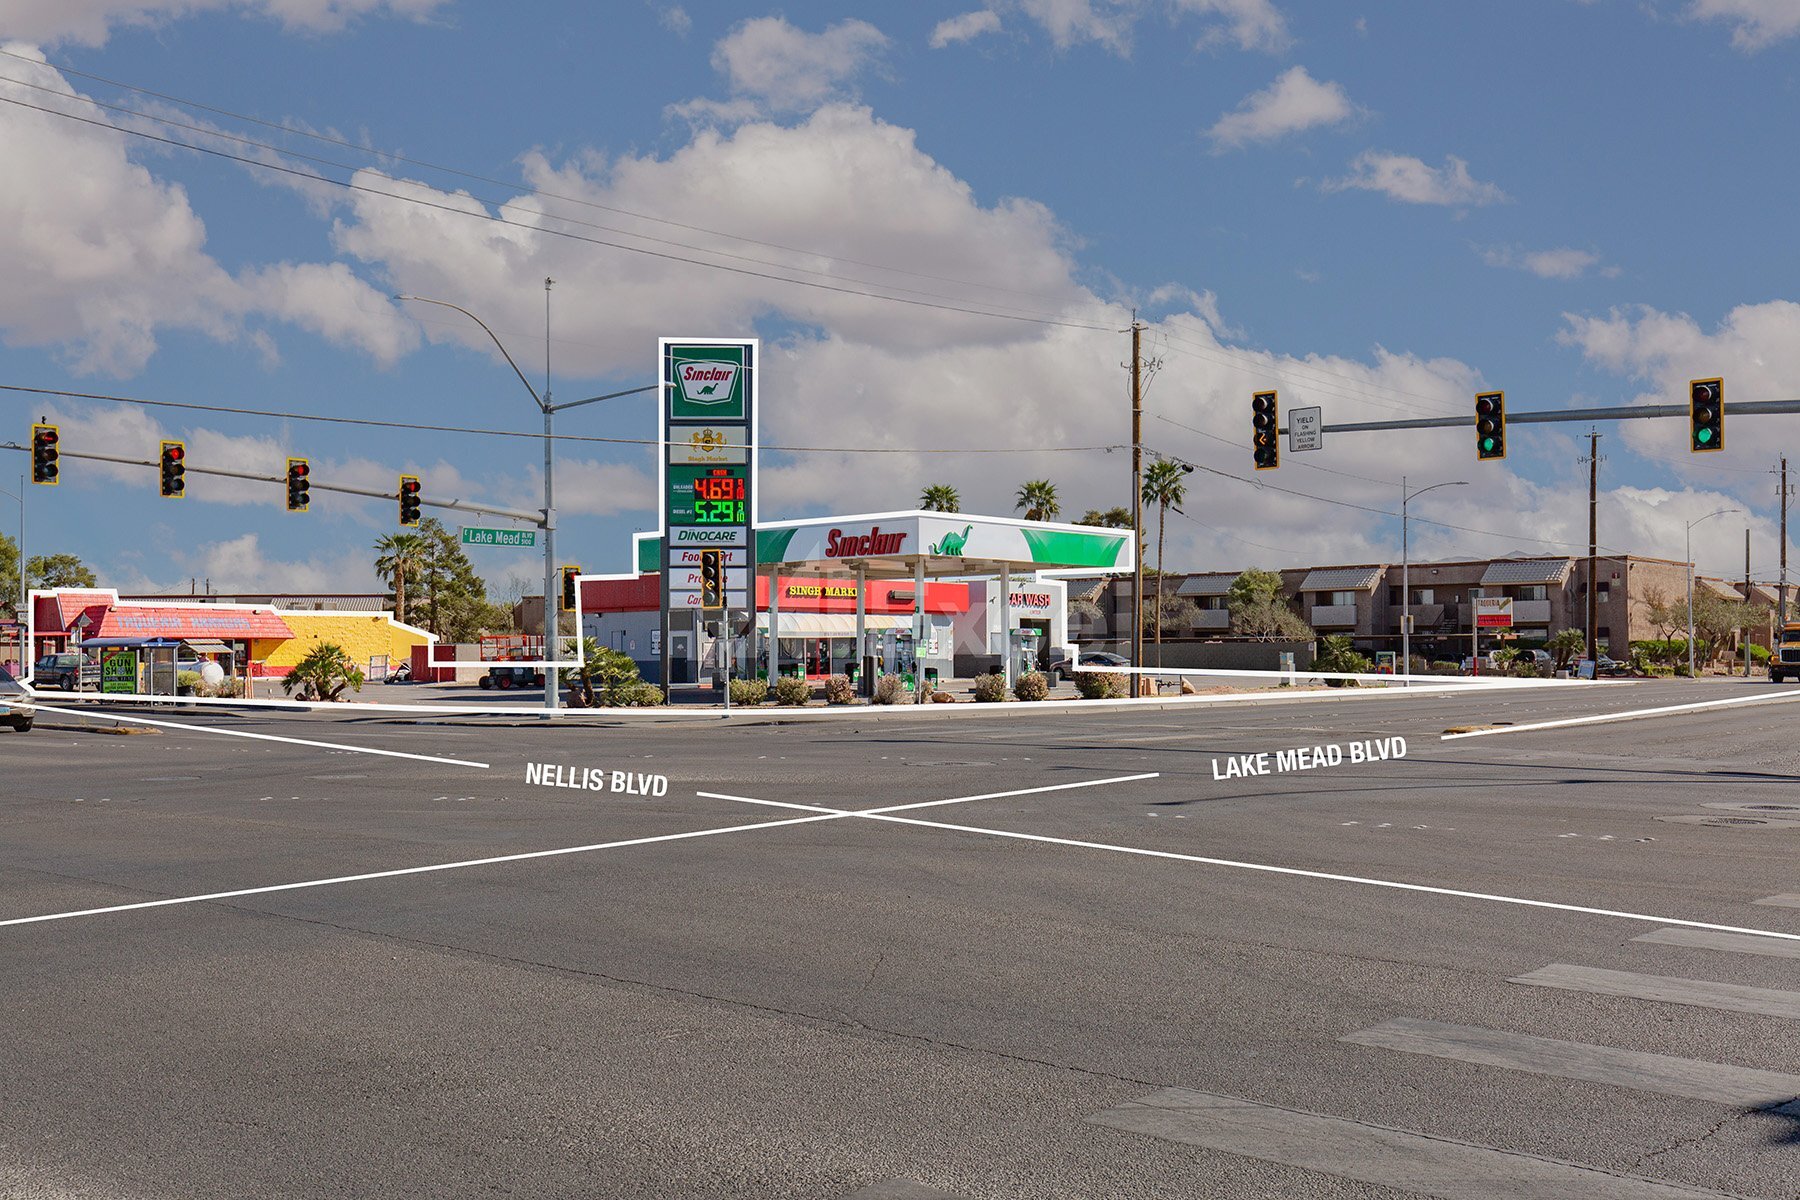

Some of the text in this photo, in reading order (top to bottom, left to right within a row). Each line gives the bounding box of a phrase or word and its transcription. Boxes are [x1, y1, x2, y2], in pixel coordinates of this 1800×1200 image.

[684, 366, 733, 381] Sinclair
[694, 479, 734, 500] 4.69
[694, 501, 734, 522] 5.29
[469, 530, 493, 543] Lake
[495, 531, 520, 545] Mead
[678, 531, 738, 541] DINOCARE
[825, 526, 907, 557] Sinclair
[682, 552, 702, 562] Foo
[789, 585, 821, 596] SINGH
[1008, 593, 1051, 606] AR WASH
[109, 659, 131, 667] GUN
